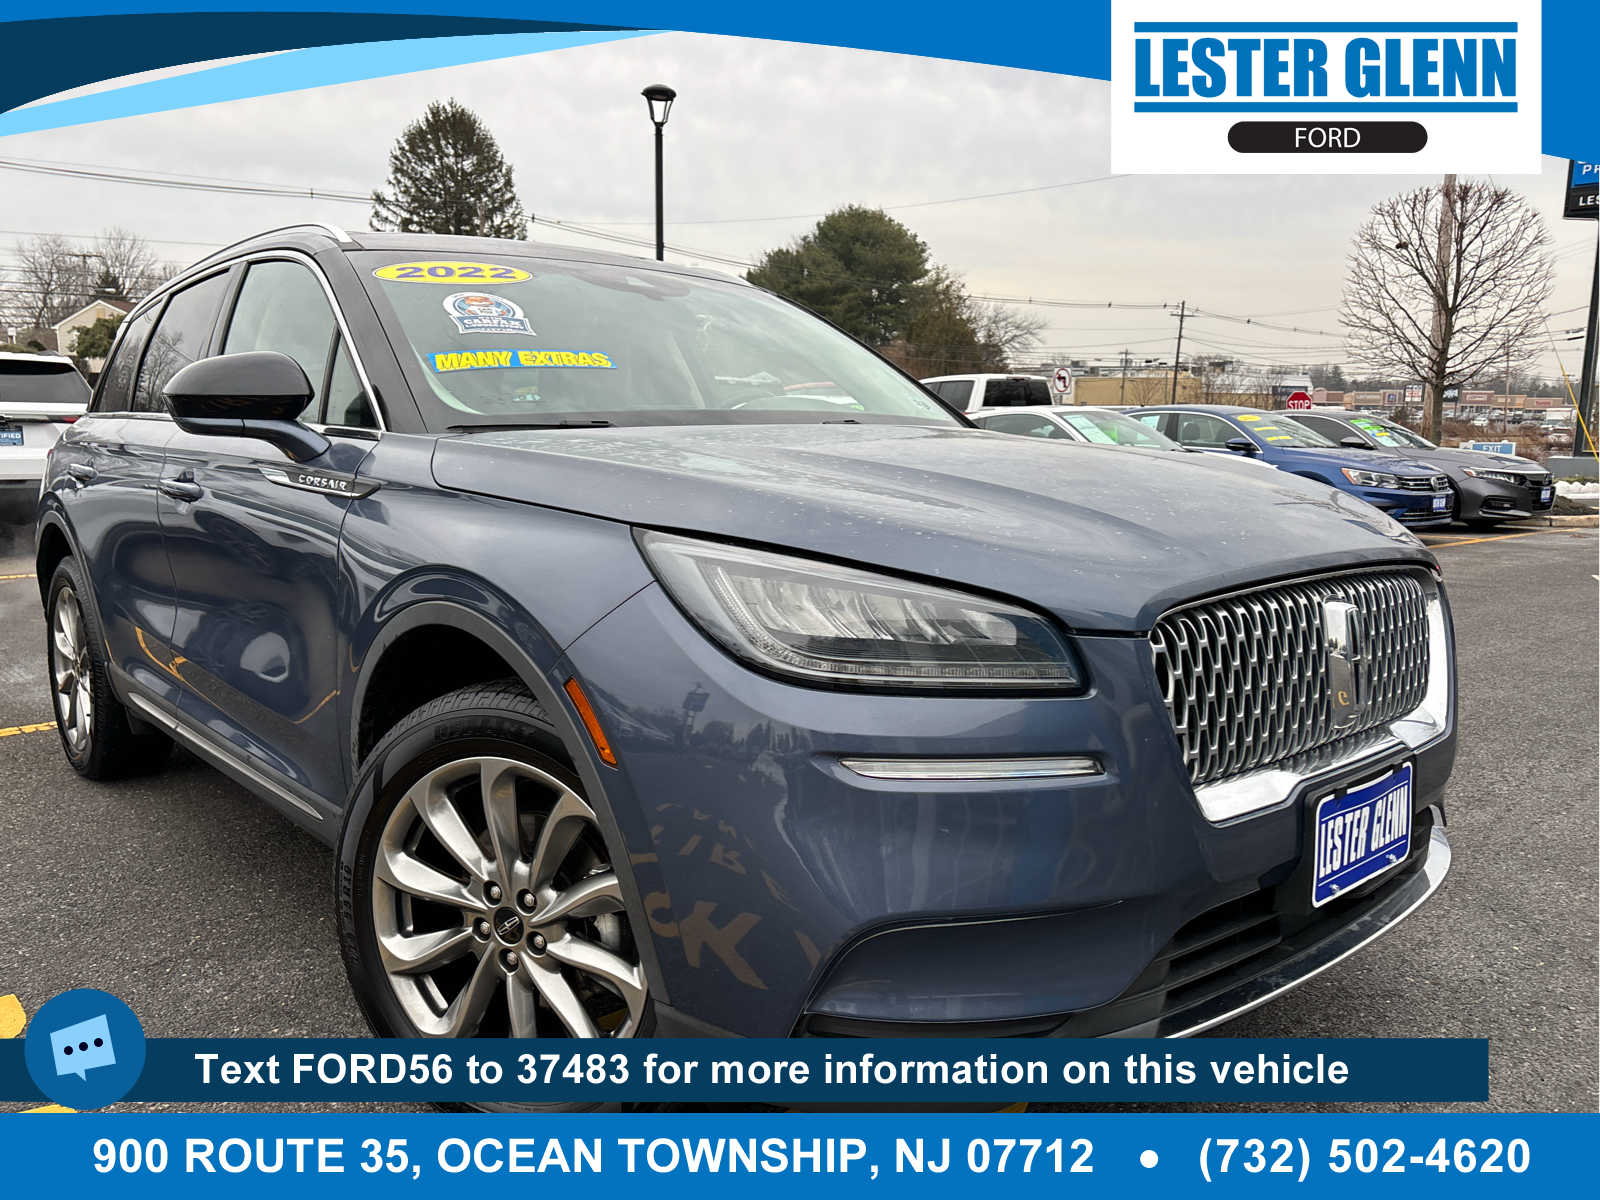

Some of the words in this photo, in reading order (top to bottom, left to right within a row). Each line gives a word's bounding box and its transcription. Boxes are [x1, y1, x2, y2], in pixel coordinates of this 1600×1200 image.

[396, 265, 517, 279] 2022
[435, 351, 513, 371] MANY
[519, 350, 612, 368] EXTRAS
[1288, 400, 1310, 410] STOP
[1482, 445, 1502, 453] EXIT
[298, 474, 348, 491] CORSAIR
[1318, 805, 1370, 879] LESTER
[1370, 784, 1408, 852] GLENN
